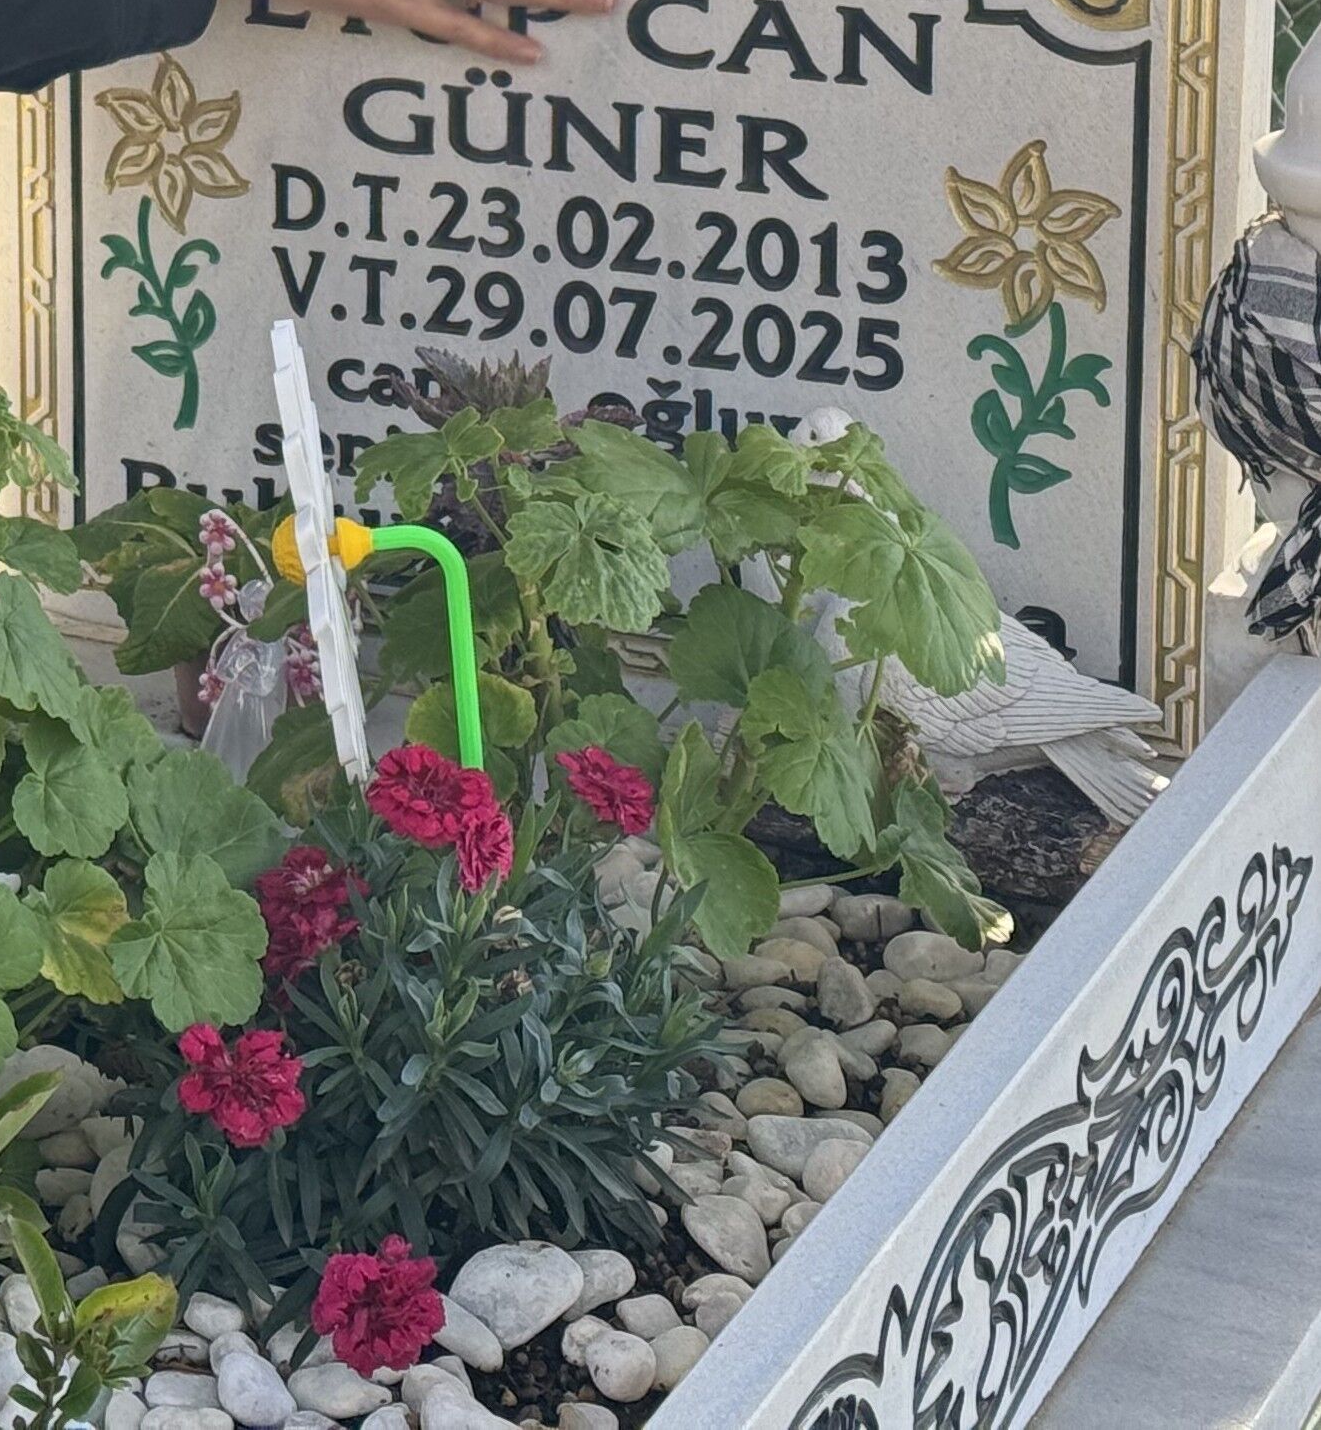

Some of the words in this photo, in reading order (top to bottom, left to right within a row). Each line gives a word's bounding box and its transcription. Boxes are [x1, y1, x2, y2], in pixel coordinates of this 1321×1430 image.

[342, 67, 830, 202] GÜNER
[271, 162, 909, 305] D.T.23.02.2013
[271, 245, 906, 392] V.T.29.07.2025
